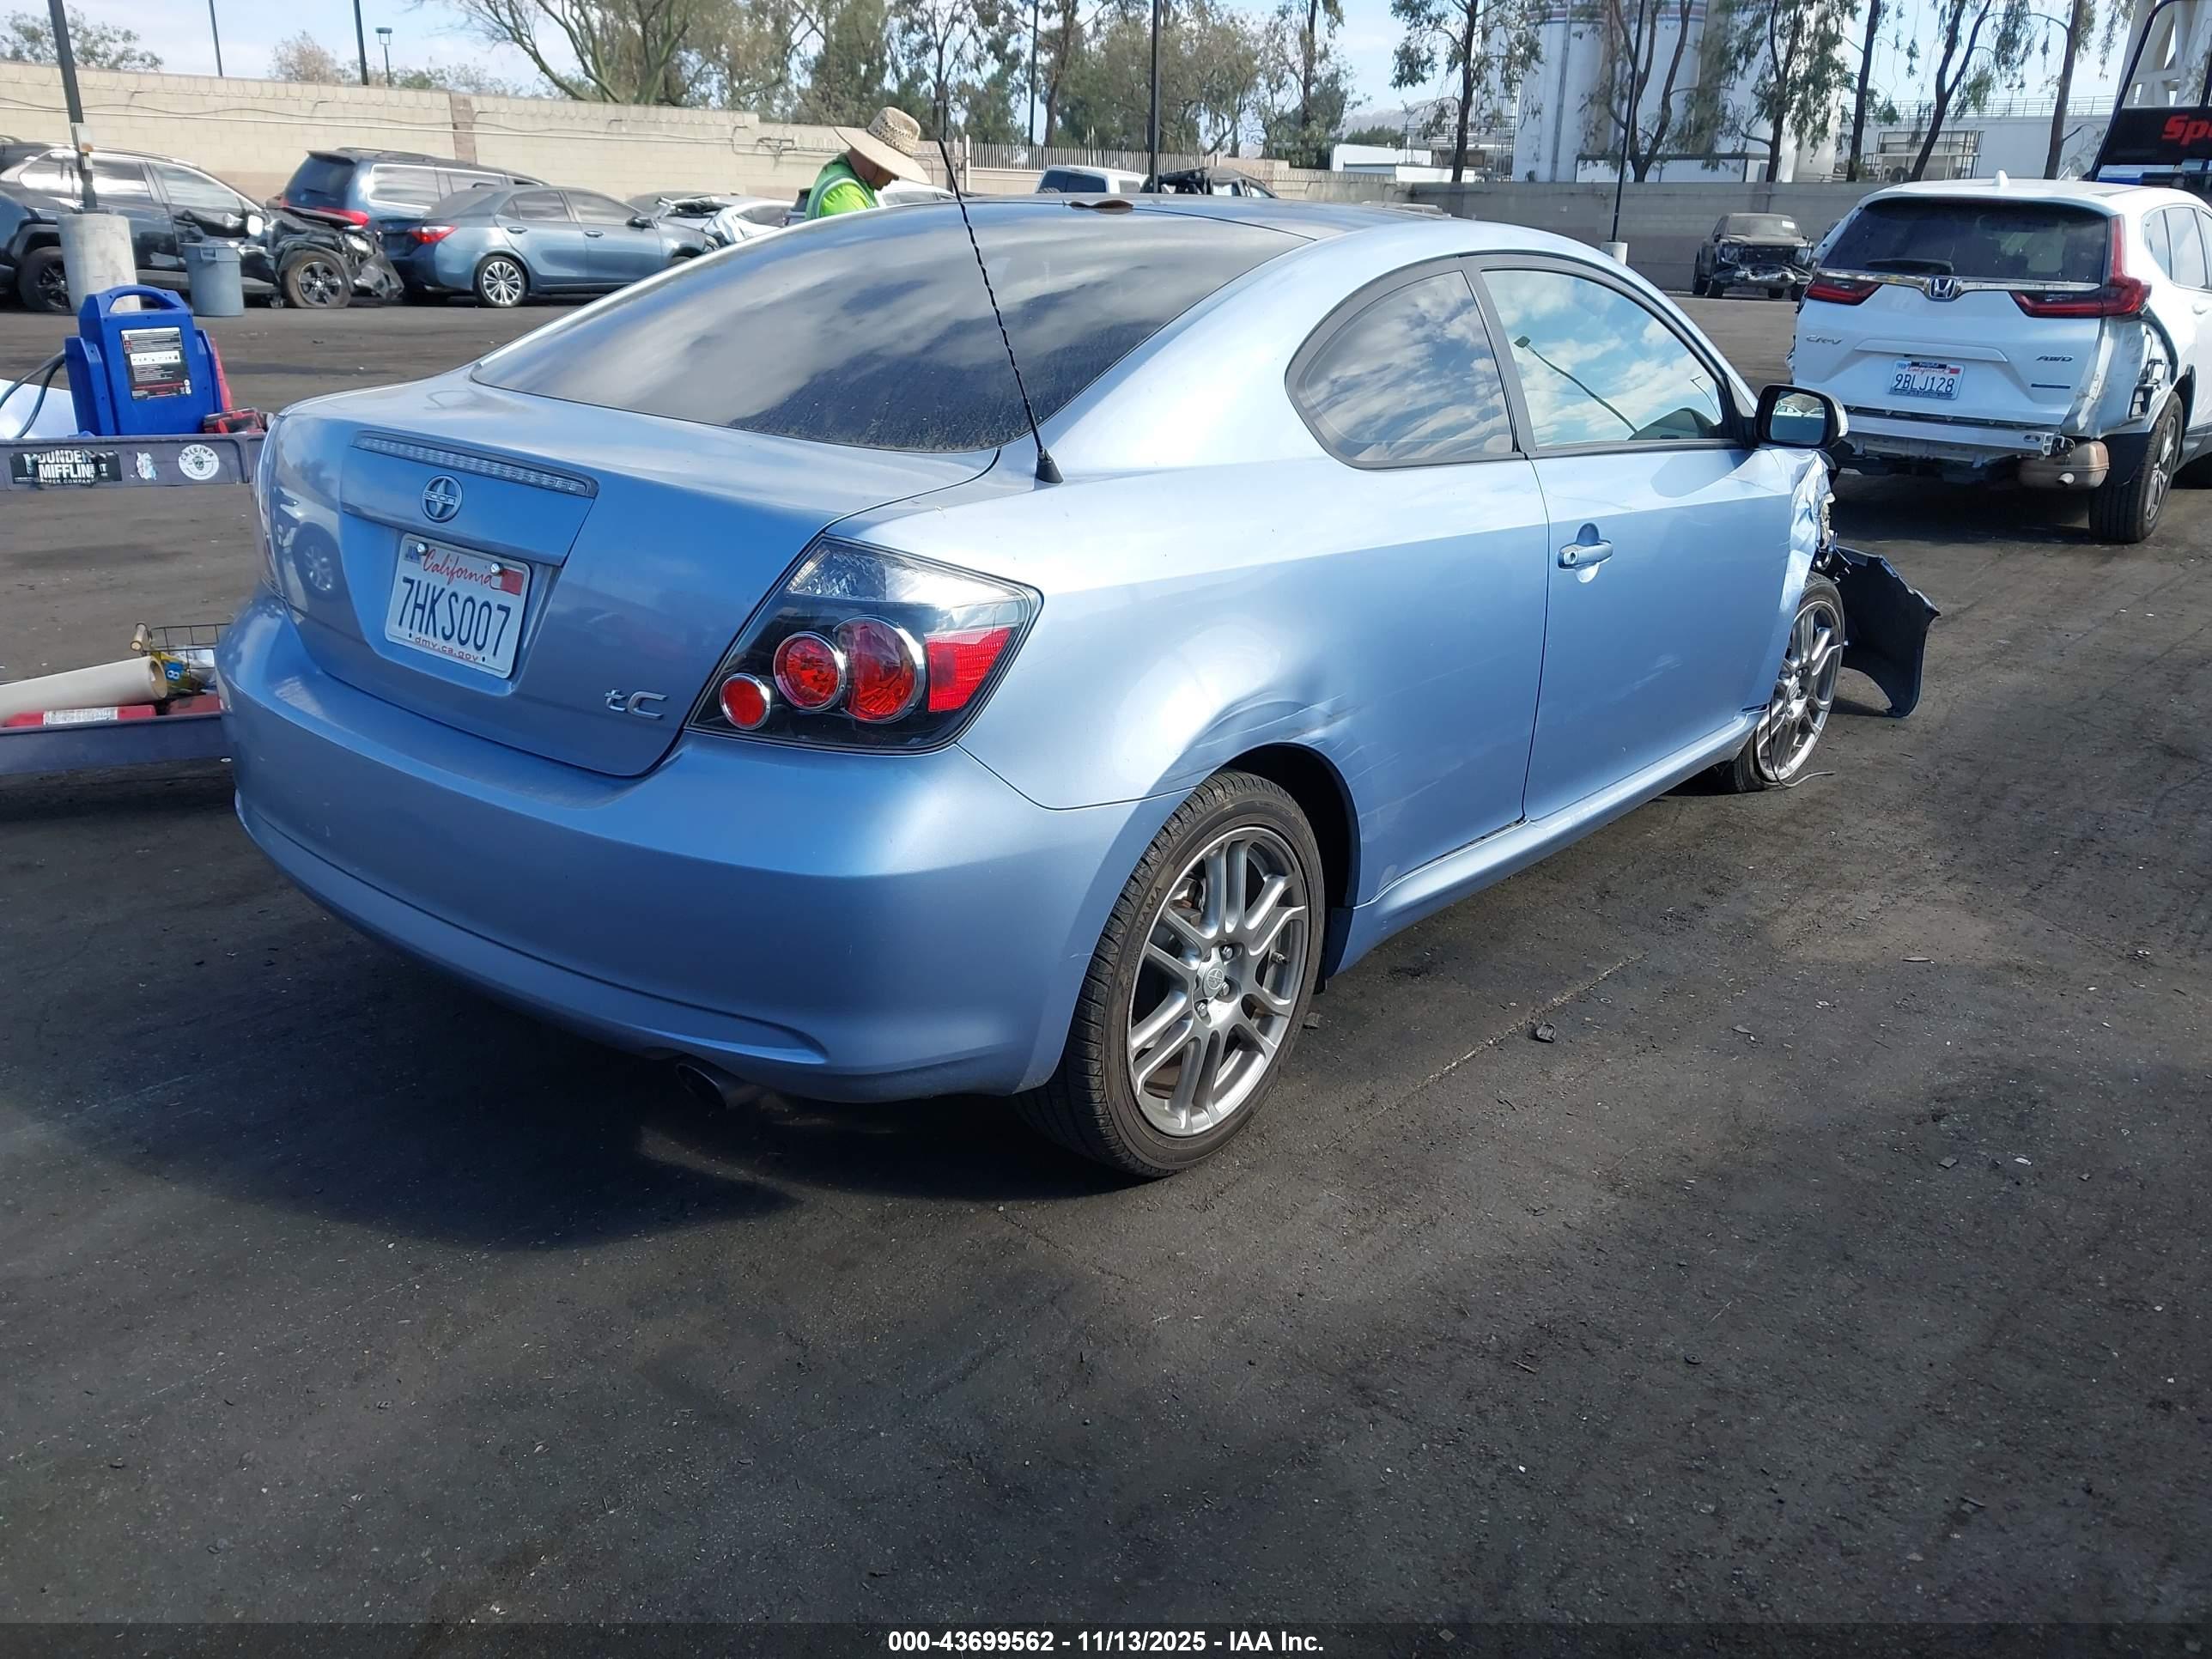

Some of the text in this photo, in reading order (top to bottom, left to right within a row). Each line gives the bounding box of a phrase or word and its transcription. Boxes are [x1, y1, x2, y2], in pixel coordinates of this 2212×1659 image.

[1894, 373, 1955, 393] 9BLJ128
[422, 549, 495, 587] California
[398, 576, 511, 658] 7HKS007
[415, 636, 478, 662] dmv.ca.gov
[605, 690, 667, 720] tC
